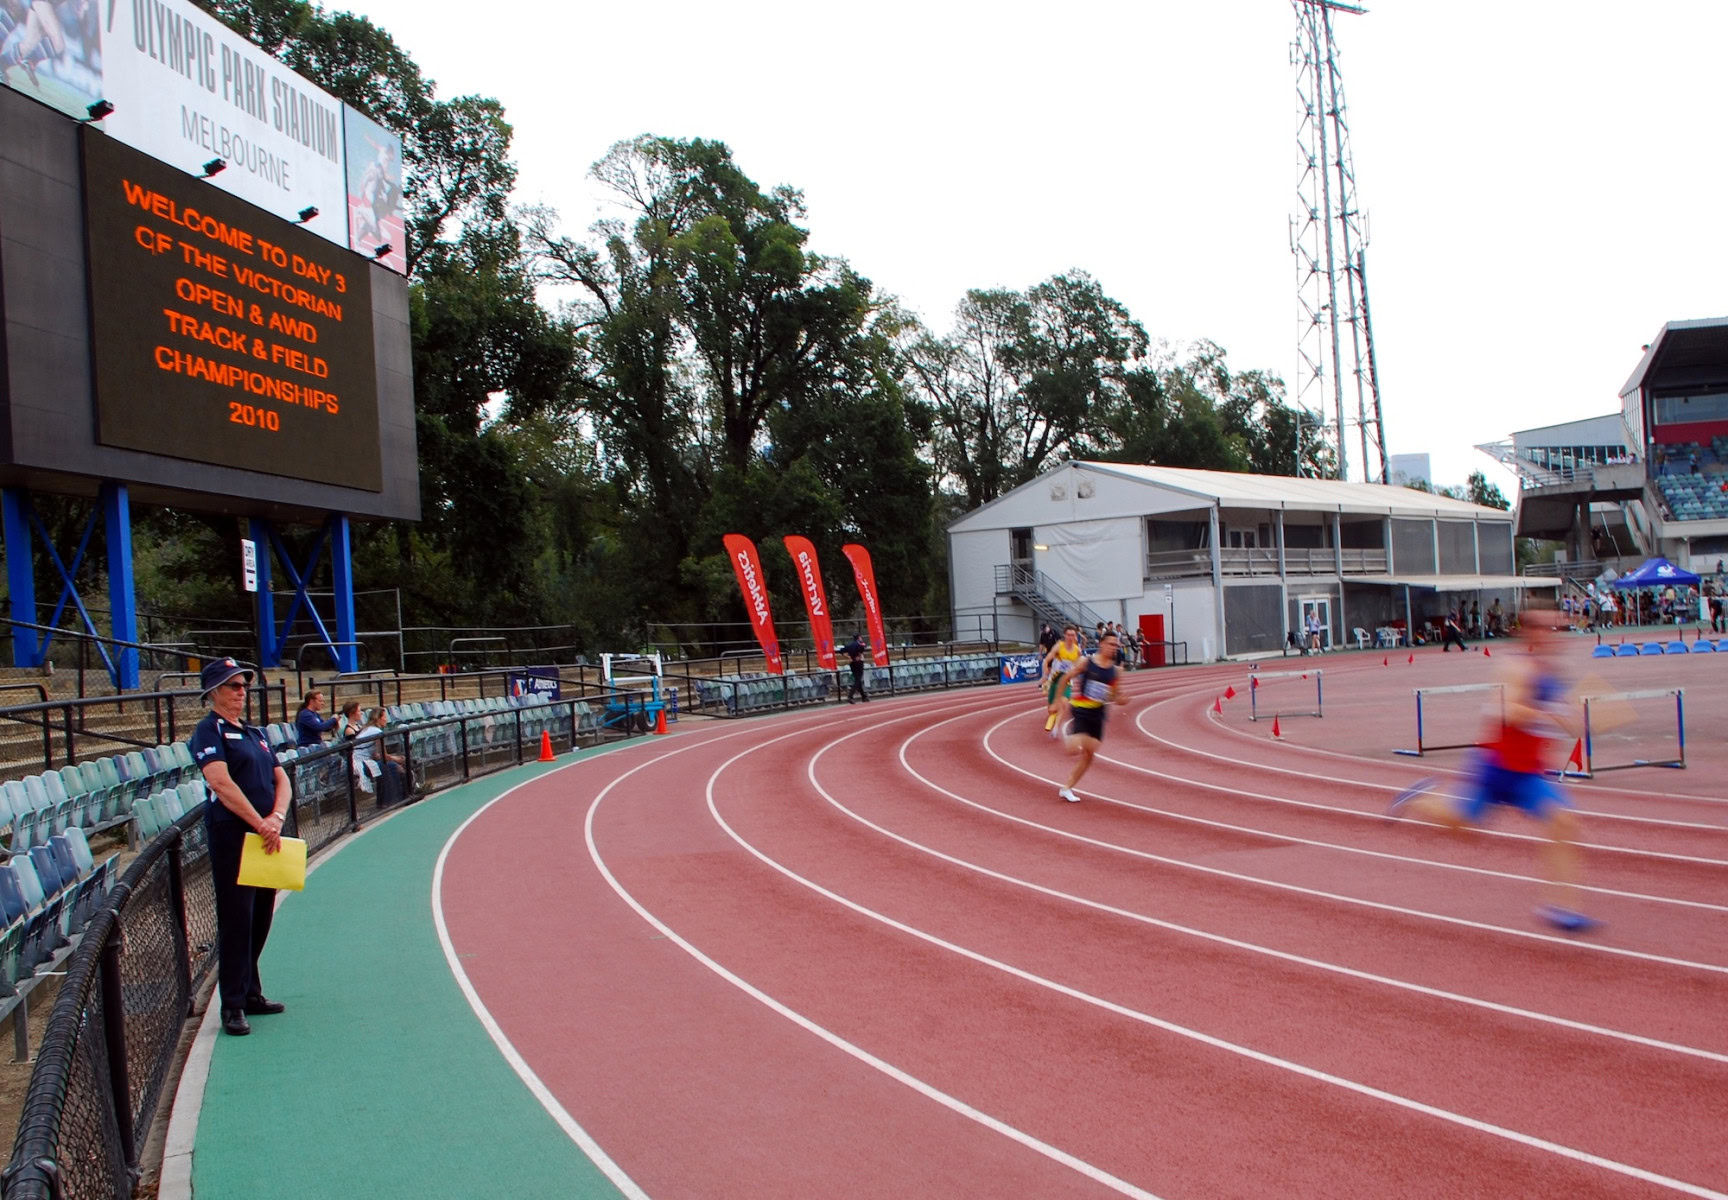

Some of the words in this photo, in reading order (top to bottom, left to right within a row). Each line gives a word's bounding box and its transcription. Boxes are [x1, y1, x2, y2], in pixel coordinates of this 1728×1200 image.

[133, 0, 216, 93] OLYMPIC
[221, 42, 268, 124] PARK
[272, 75, 338, 164] STADIUM
[181, 104, 290, 192] MELBOURNE
[122, 179, 253, 255] WELCOME
[257, 239, 287, 267] TO
[292, 257, 331, 287] DAY
[335, 274, 346, 293] 3
[175, 278, 243, 320] OPEN
[249, 305, 263, 326] &
[269, 313, 317, 343] AWD
[178, 242, 228, 278] THE
[232, 264, 342, 322] VICTORIAN
[154, 346, 339, 414] CHAMPIONSHIPS
[163, 309, 247, 354] TRACK
[253, 339, 268, 360] &
[272, 344, 328, 378] FIELD
[229, 402, 279, 432] 2010
